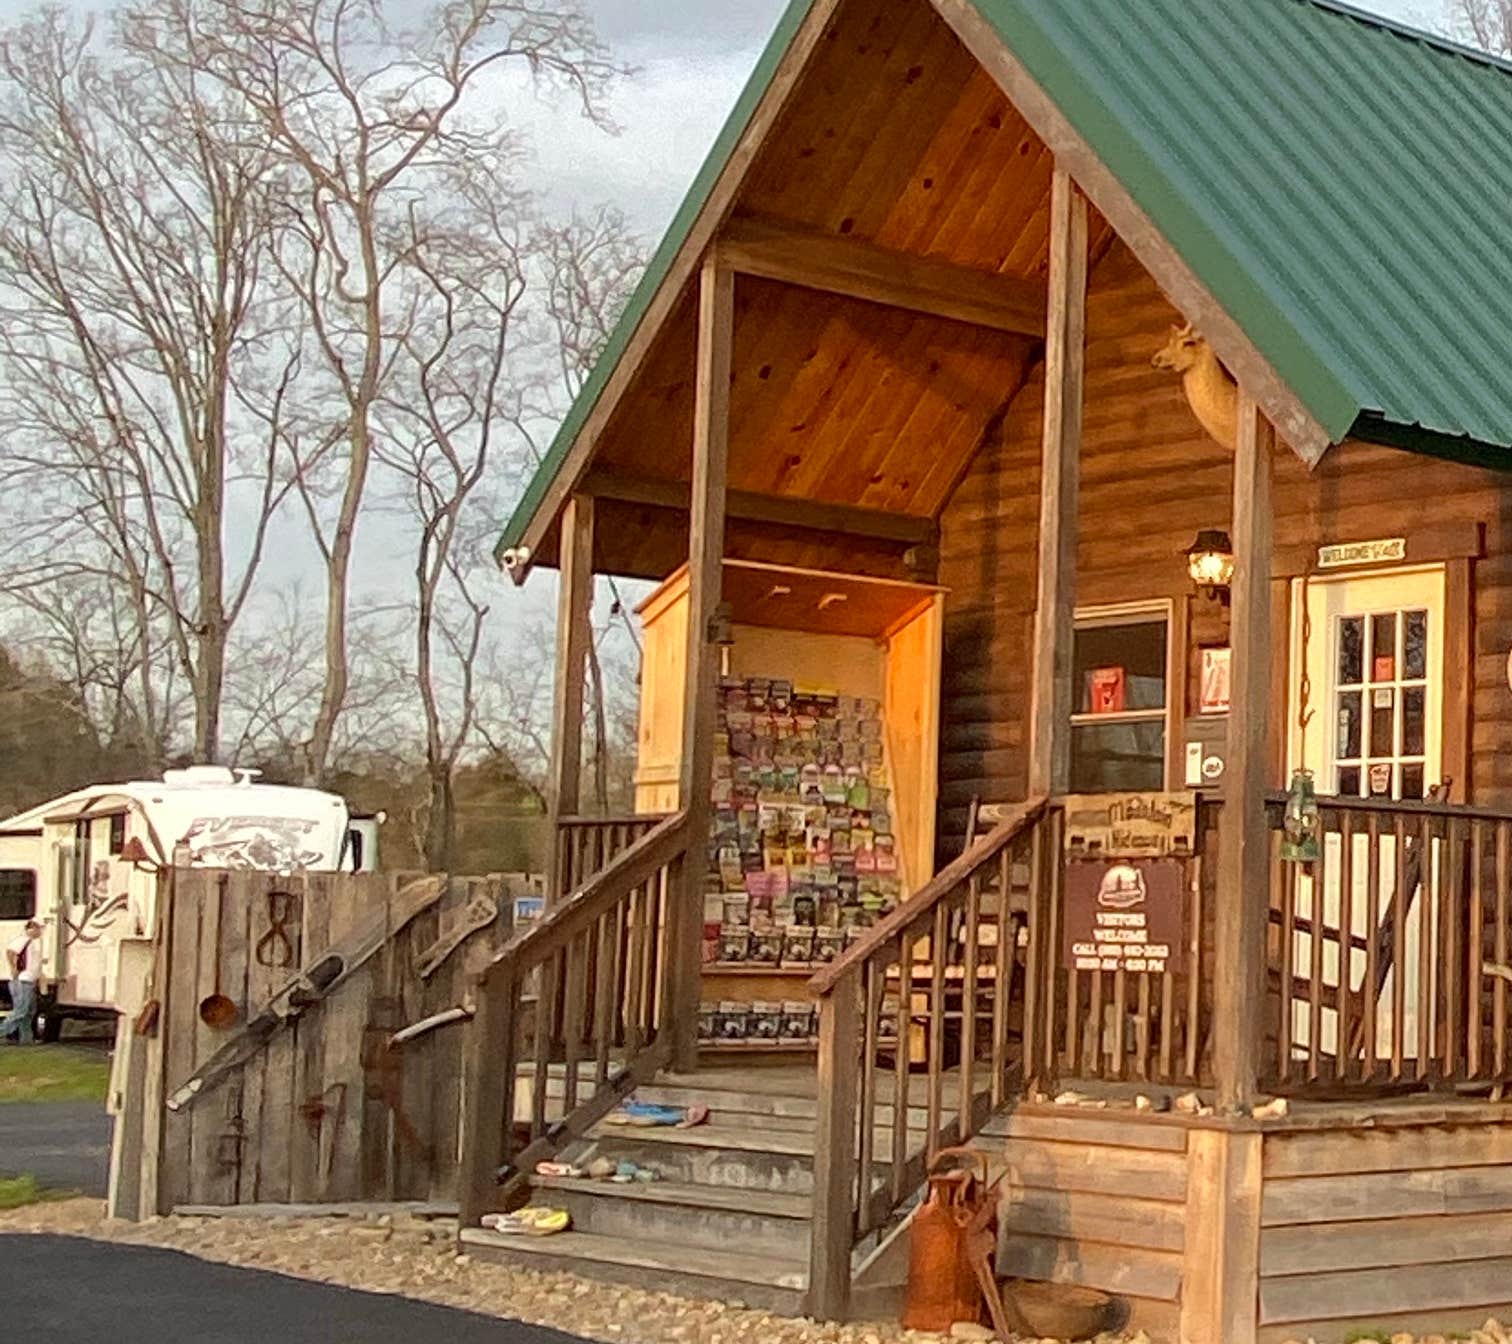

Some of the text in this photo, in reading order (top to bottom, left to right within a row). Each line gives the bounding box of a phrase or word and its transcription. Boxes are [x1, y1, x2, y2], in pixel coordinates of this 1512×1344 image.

[1093, 929, 1147, 943] WELCOME
[1072, 943, 1097, 955] CALL
[1148, 960, 1165, 972] PM
